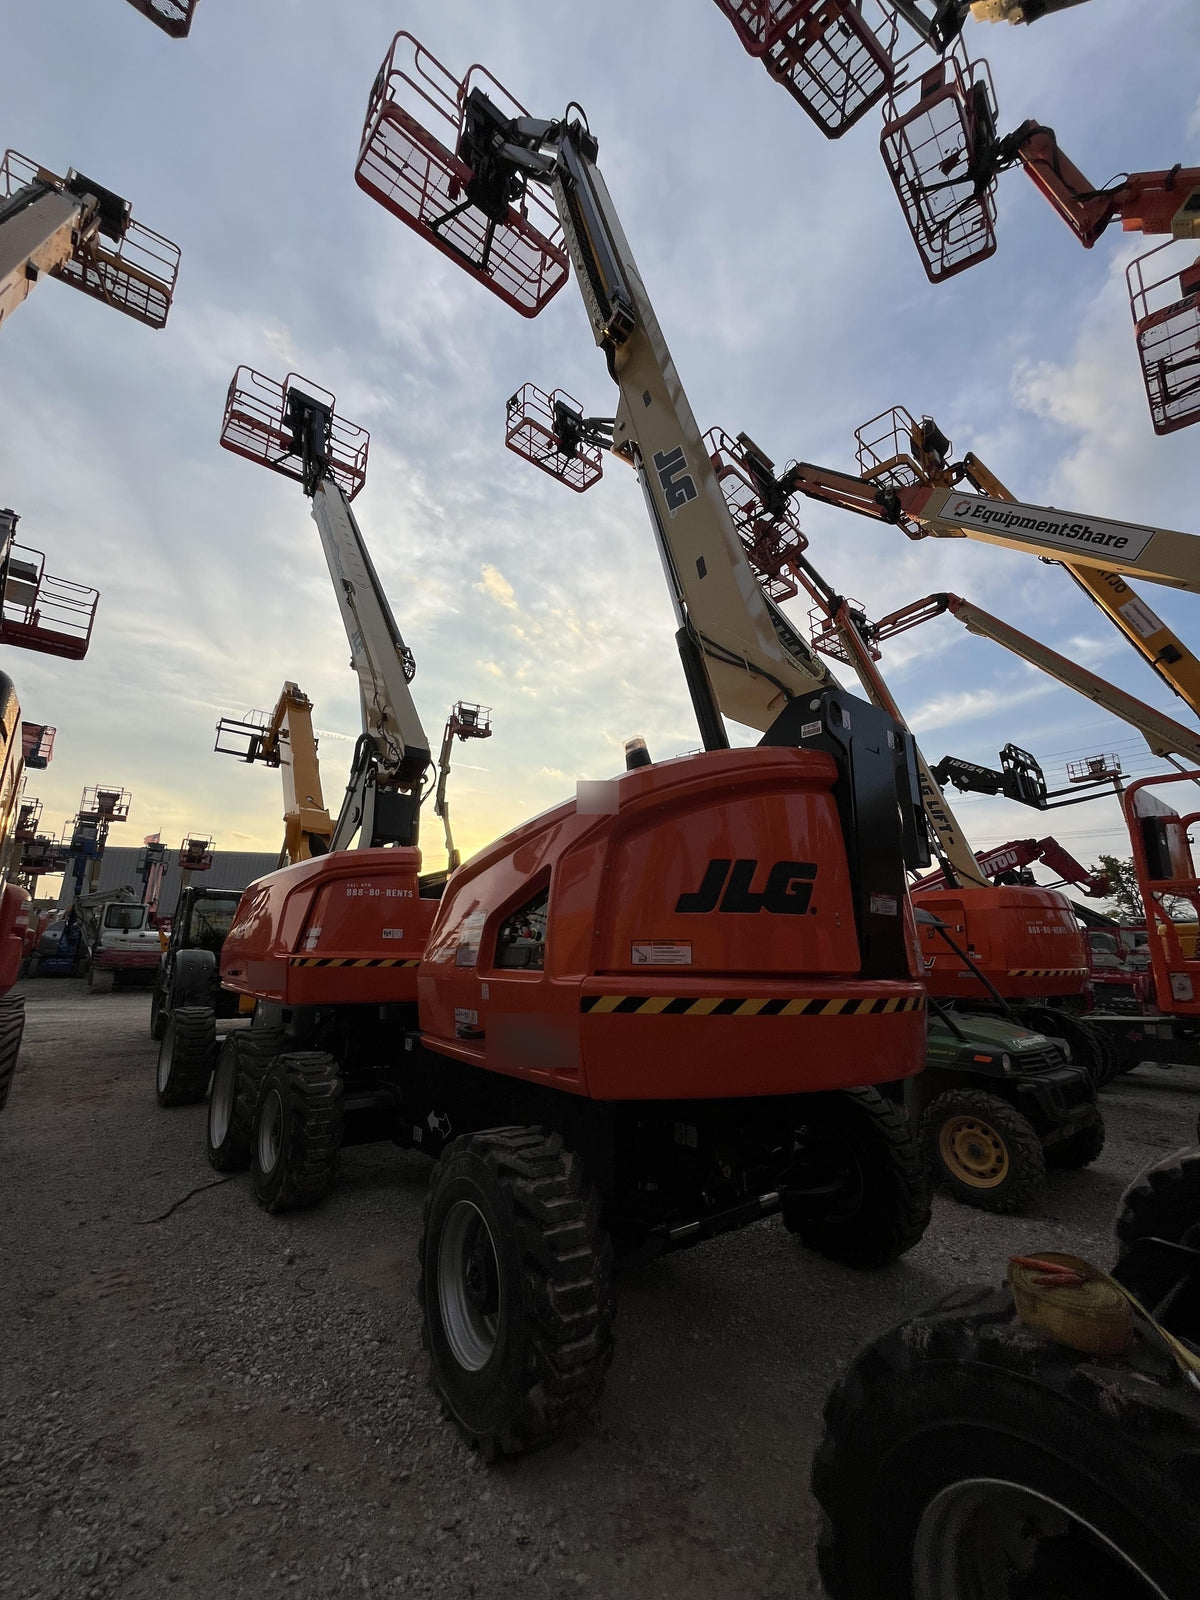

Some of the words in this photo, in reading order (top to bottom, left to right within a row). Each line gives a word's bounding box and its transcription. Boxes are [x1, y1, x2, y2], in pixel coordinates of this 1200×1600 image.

[652, 445, 698, 512] JLG
[970, 504, 1129, 549] EquipmentShare
[948, 759, 985, 775] 12054
[926, 800, 954, 833] LIFT
[346, 888, 414, 898] 888-80-RENTS
[675, 859, 818, 915] JLG
